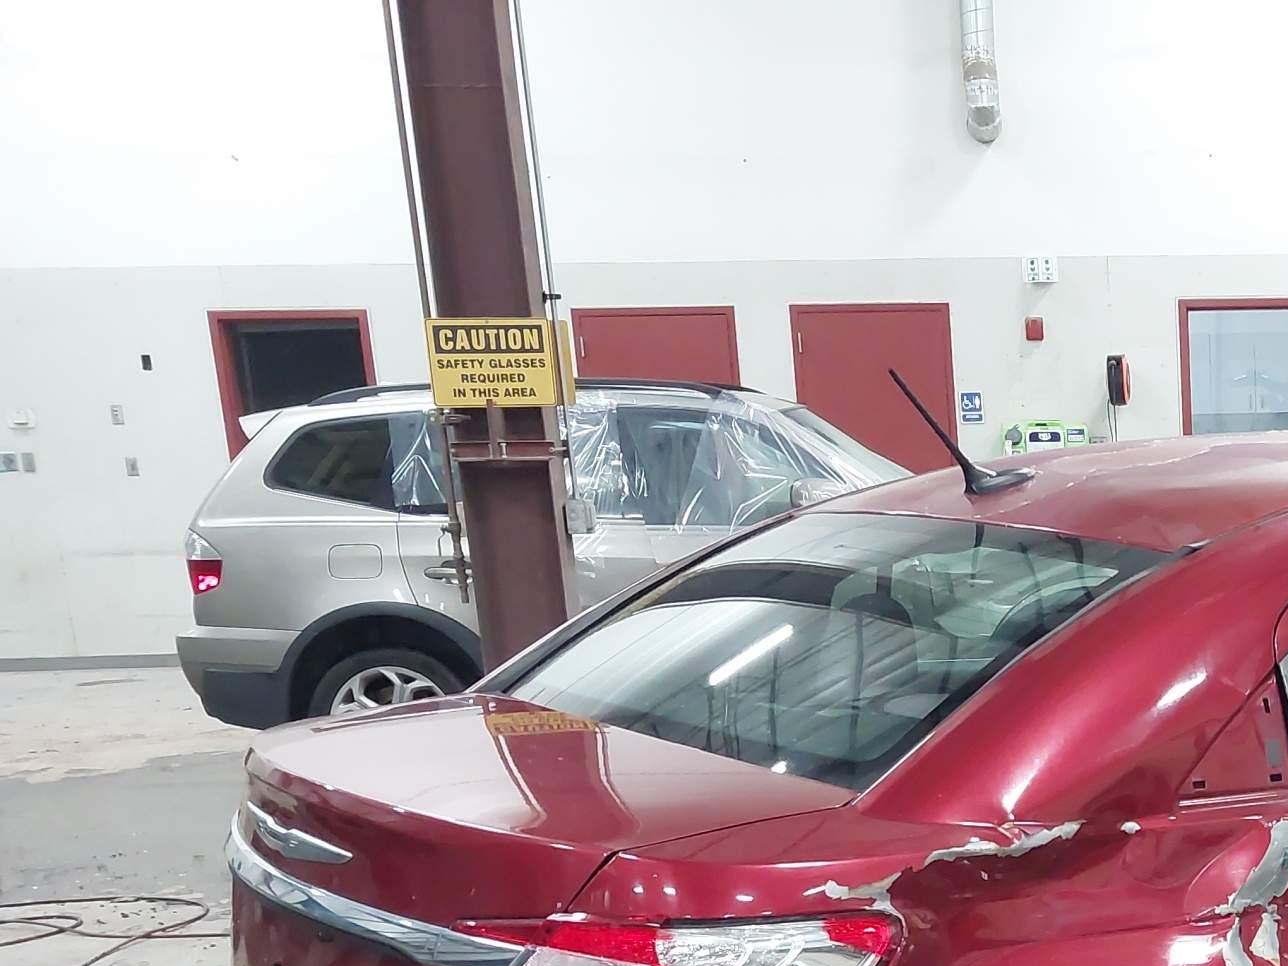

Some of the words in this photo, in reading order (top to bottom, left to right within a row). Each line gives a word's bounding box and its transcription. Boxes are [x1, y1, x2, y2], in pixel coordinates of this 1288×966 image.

[439, 329, 540, 350] CAUTION
[437, 358, 485, 369] SAFETY
[489, 358, 546, 369] GLASSES
[461, 373, 526, 383] REQUIRED
[453, 388, 467, 398] IN
[470, 388, 500, 398] THIS
[503, 388, 537, 398] AREA
